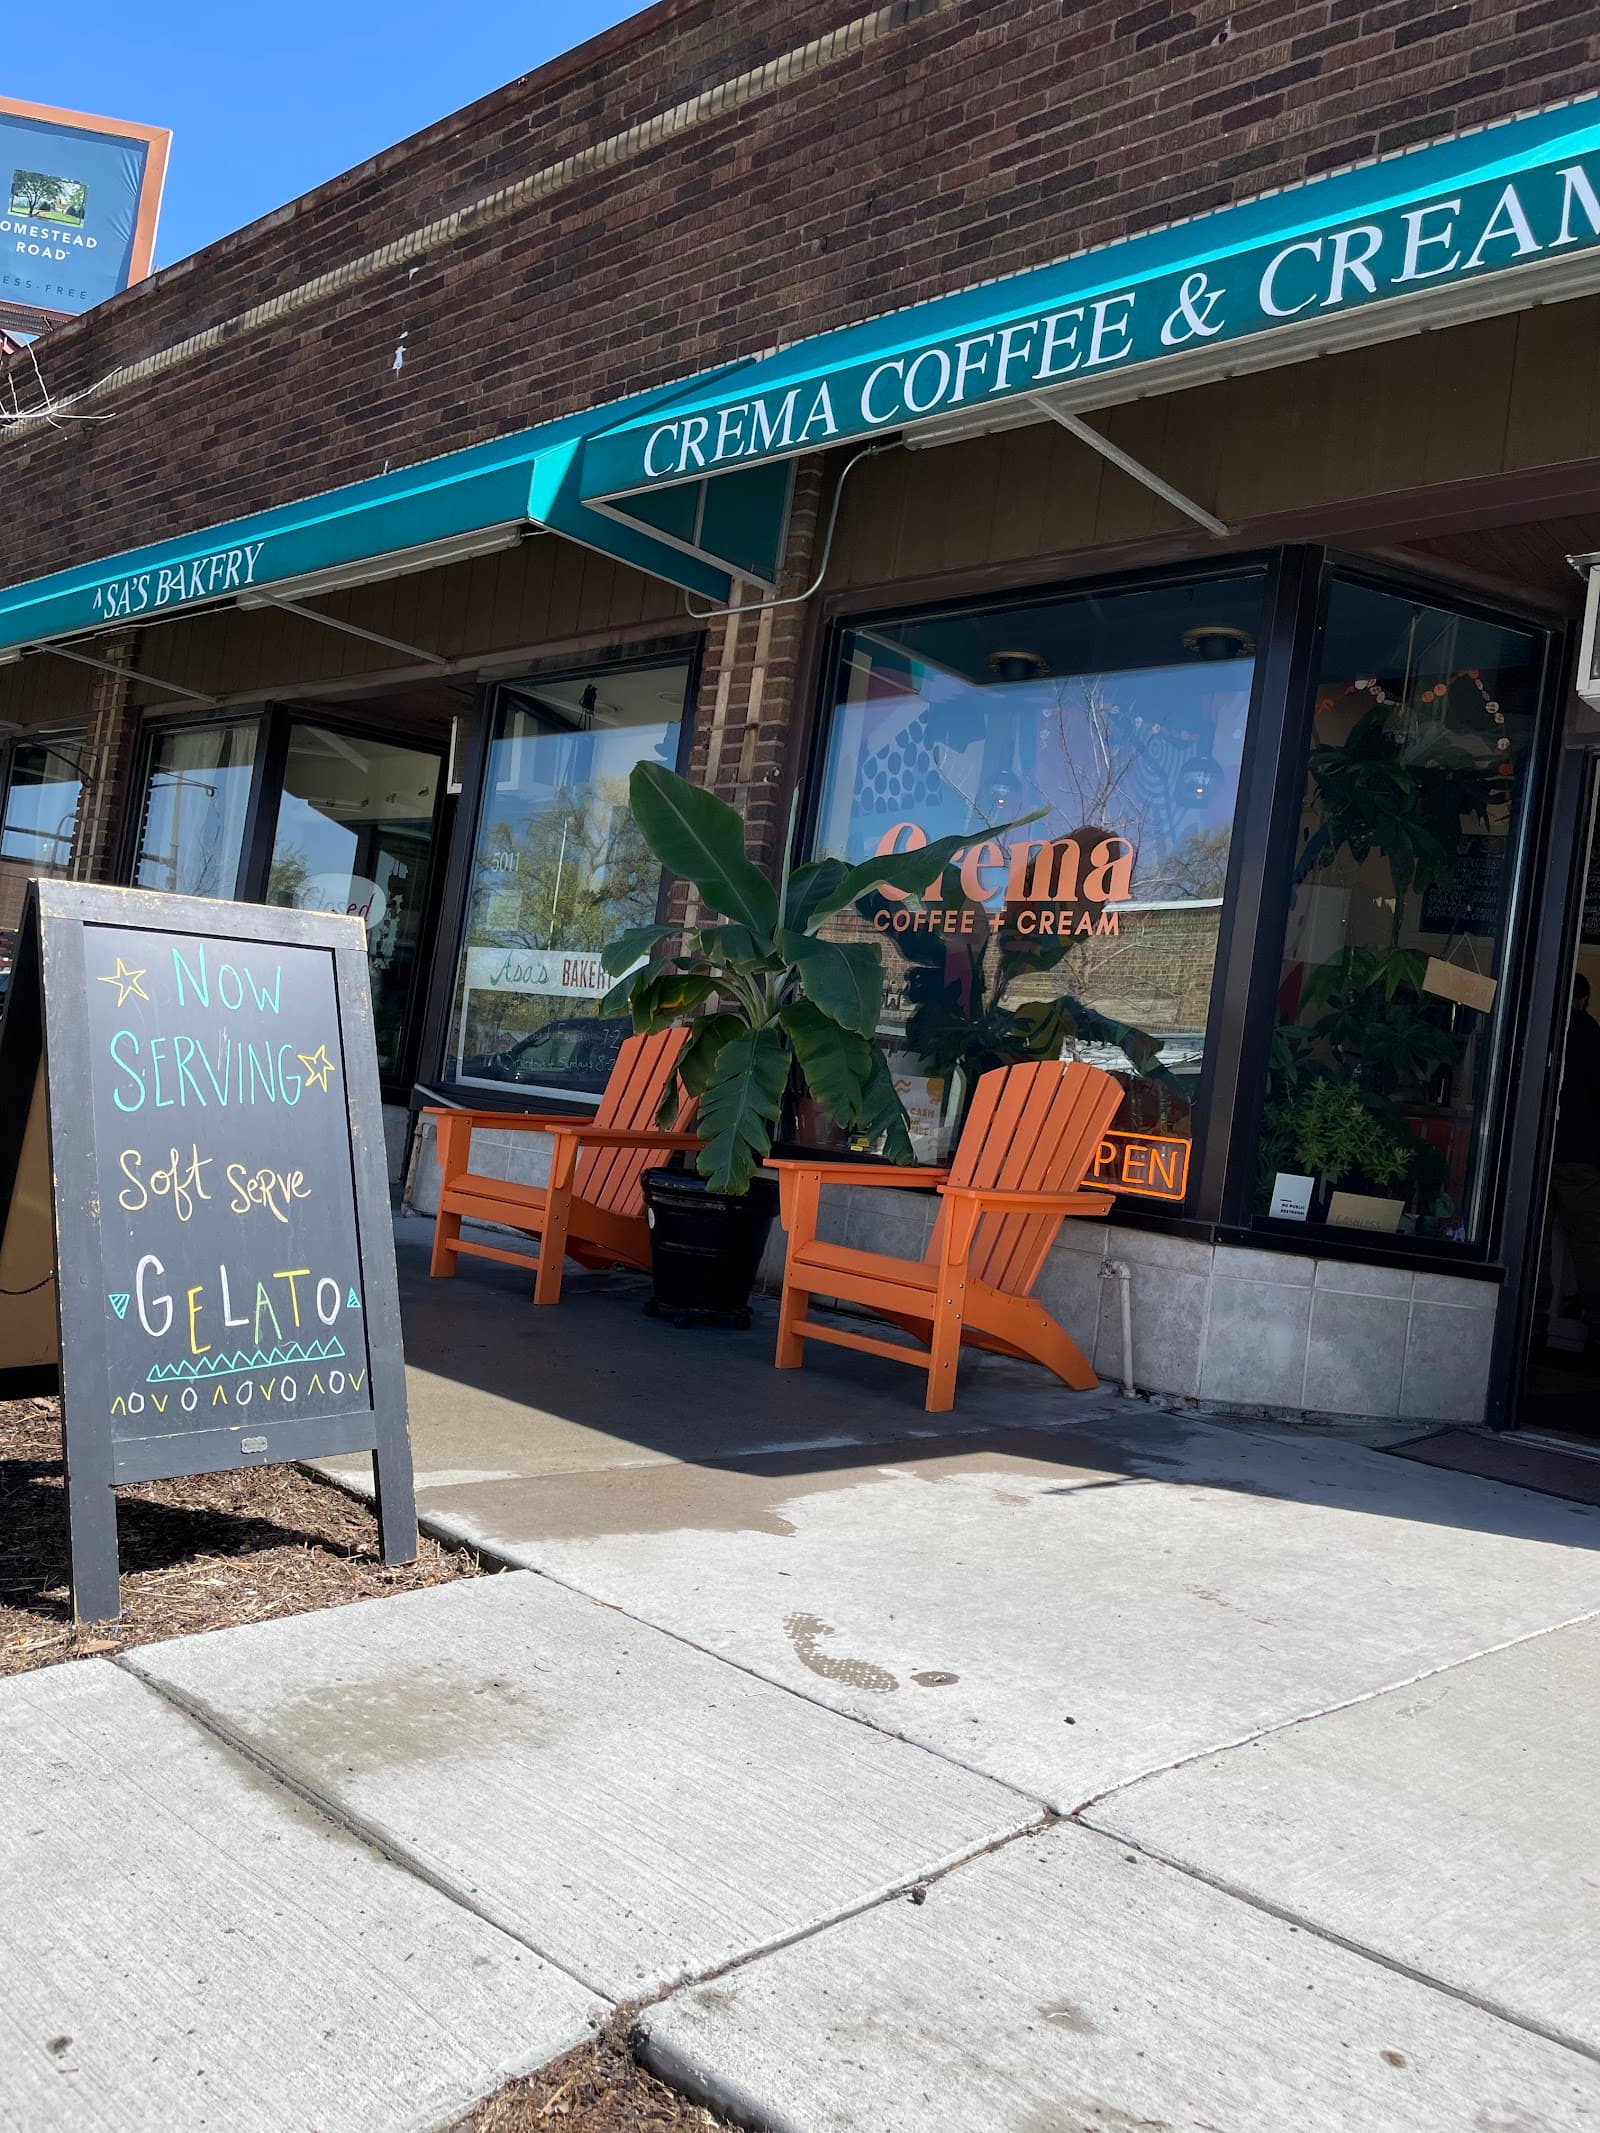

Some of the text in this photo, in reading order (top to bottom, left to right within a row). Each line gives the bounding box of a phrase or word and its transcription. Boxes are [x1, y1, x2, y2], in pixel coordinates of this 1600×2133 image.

[0, 220, 97, 248] OMESTEAD
[2, 275, 88, 299] ESS-FREE
[643, 381, 839, 476] CREMA
[860, 292, 1136, 424] COFFEE
[1160, 272, 1226, 346] &
[873, 909, 976, 934] COFFEE
[1017, 910, 1120, 936] CREAM
[110, 1029, 301, 1112] SERVING
[119, 1143, 212, 1222] Soft
[1094, 1142, 1178, 1189] PEN
[135, 1254, 341, 1355] GELATO
